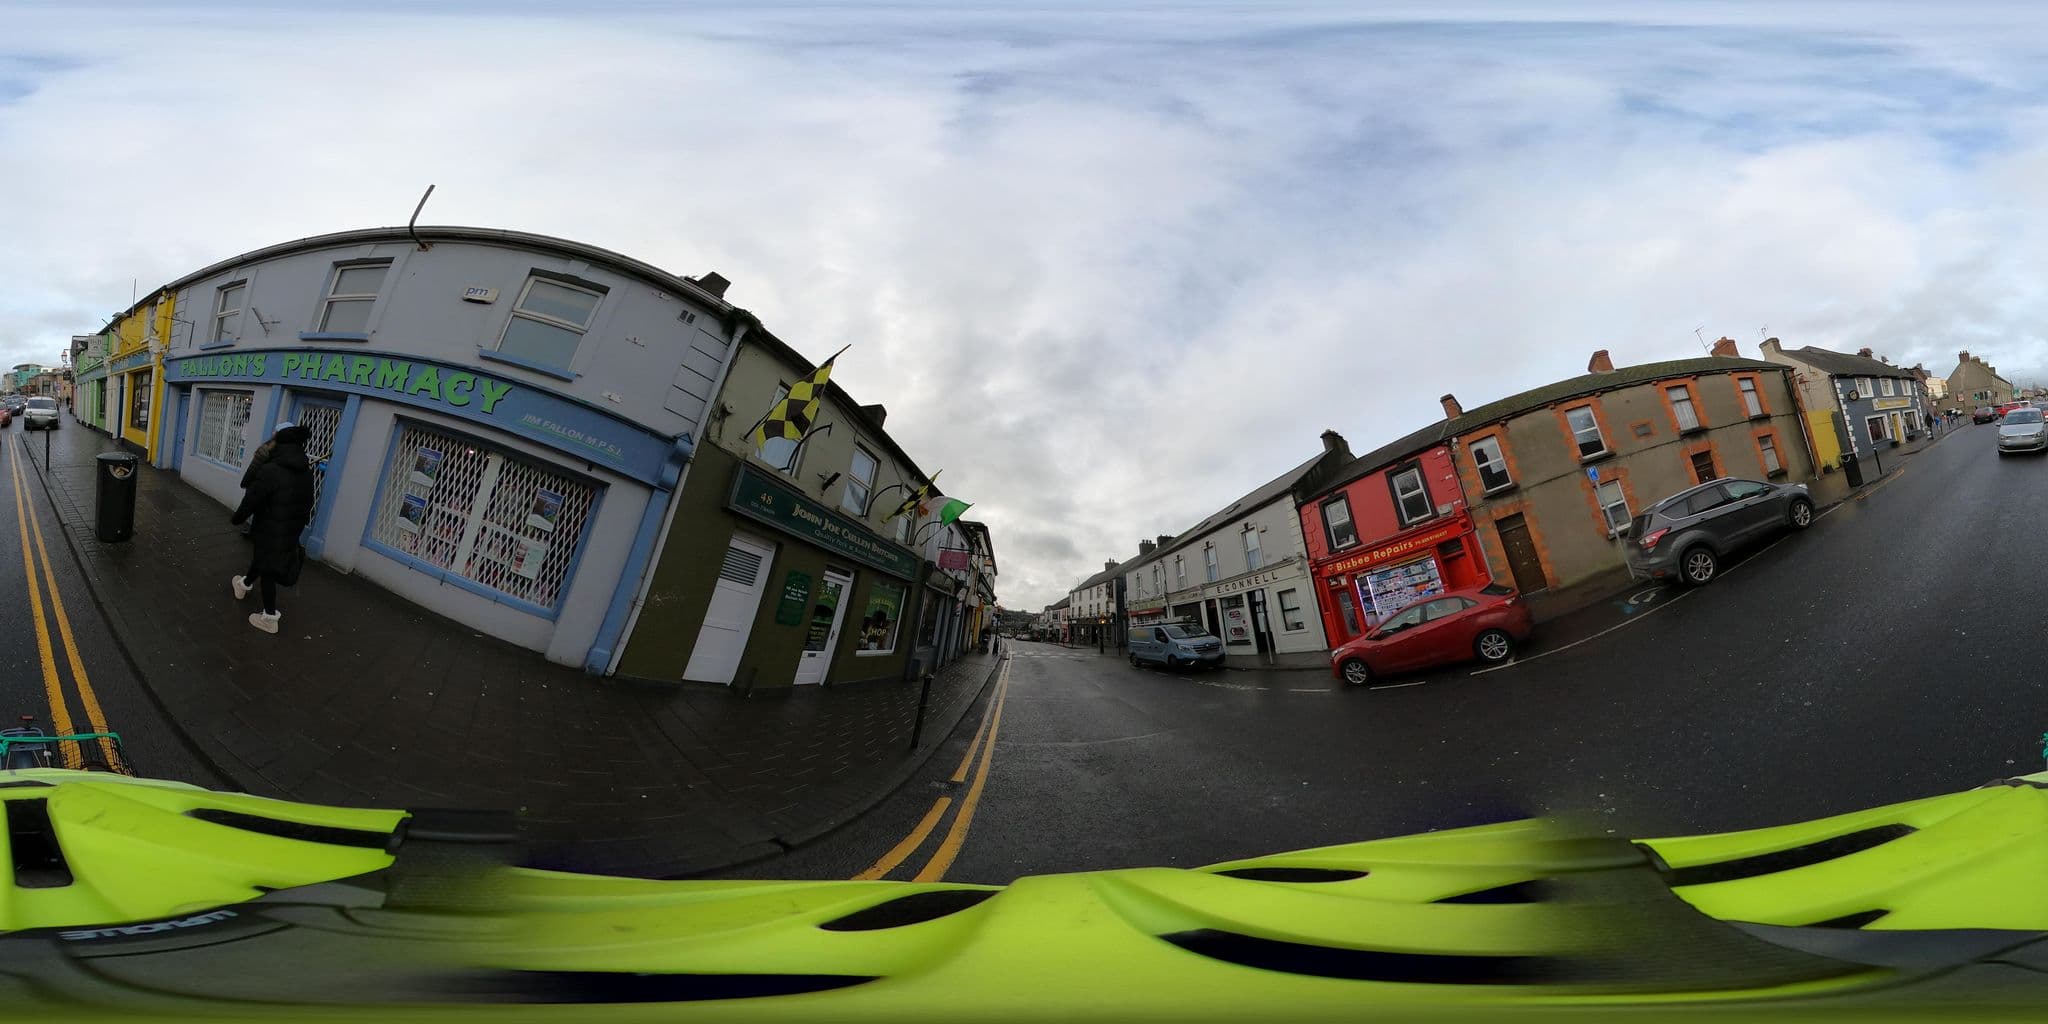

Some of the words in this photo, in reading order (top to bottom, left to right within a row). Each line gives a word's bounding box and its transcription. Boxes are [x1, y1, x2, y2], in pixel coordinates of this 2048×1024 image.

[181, 354, 267, 377] FALLON'S
[281, 352, 513, 414] PHARMACY
[522, 413, 541, 425] JIM
[542, 421, 584, 441] FALLON
[760, 493, 773, 505] 48
[1336, 555, 1371, 571] Bizbee
